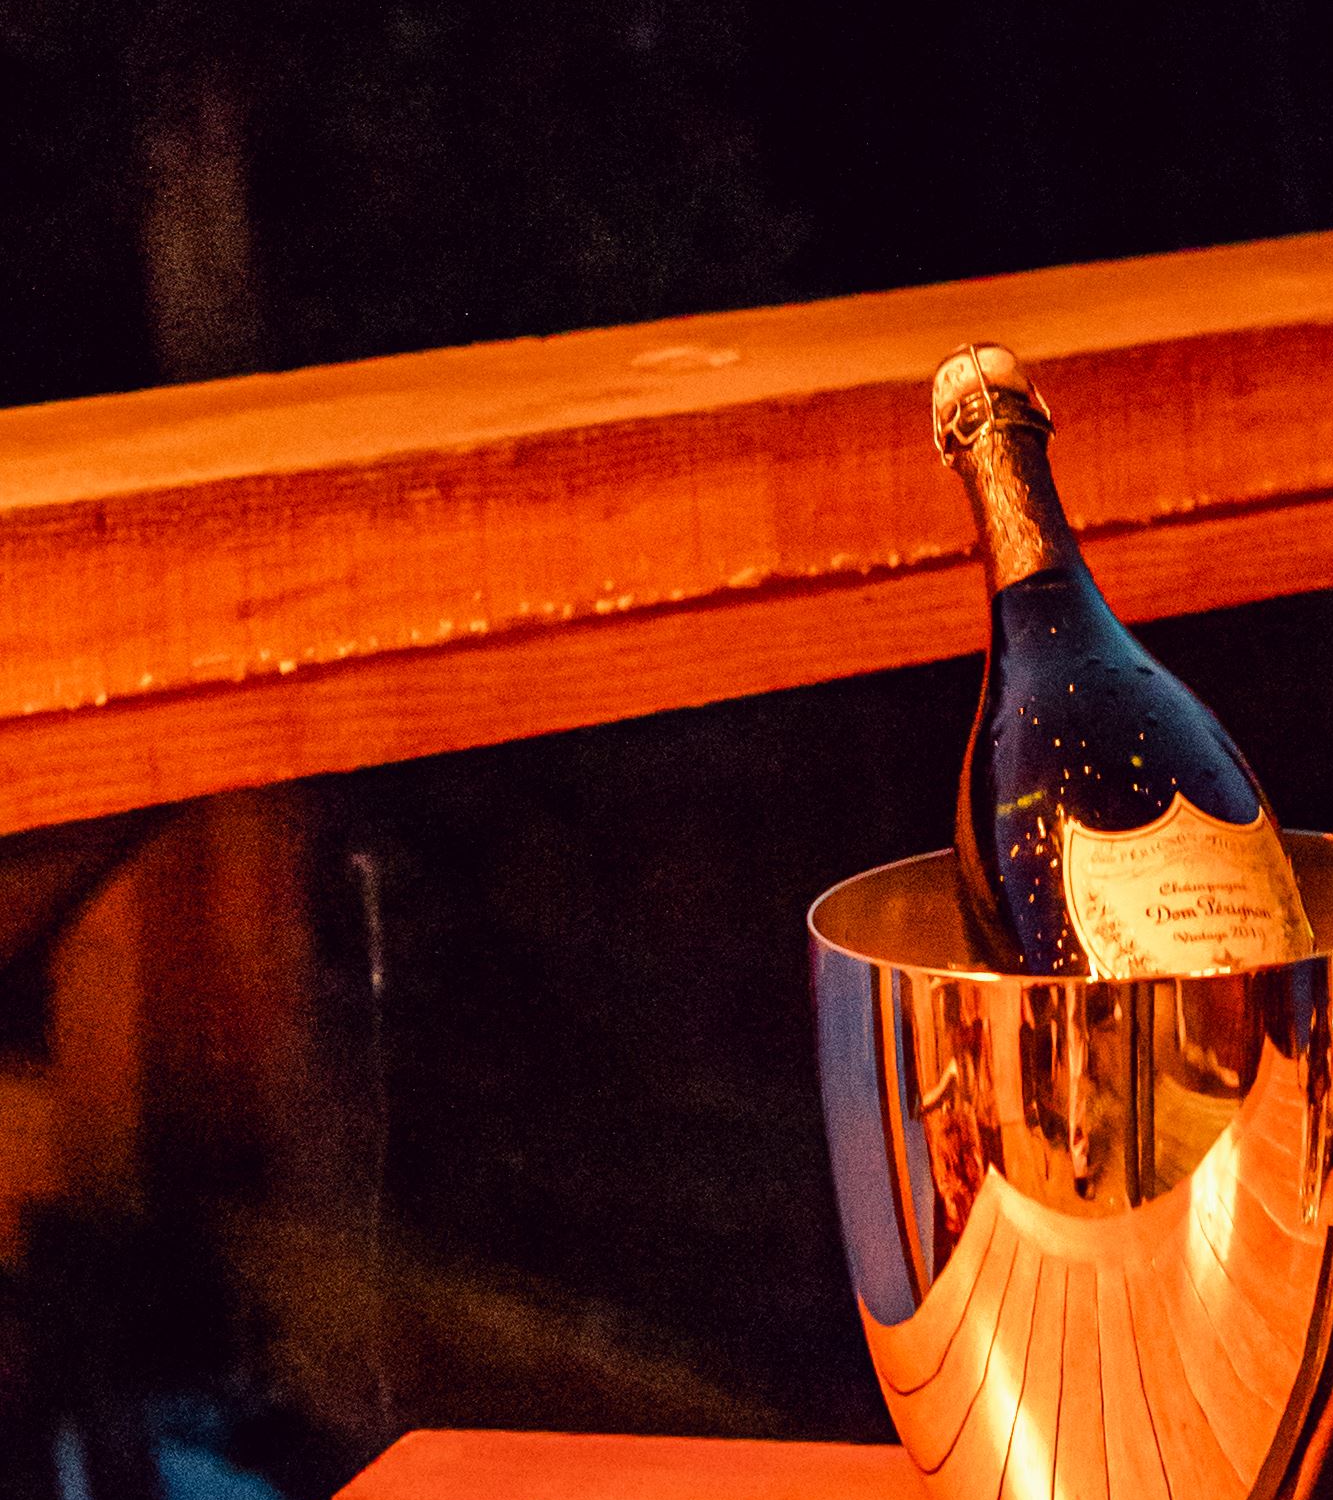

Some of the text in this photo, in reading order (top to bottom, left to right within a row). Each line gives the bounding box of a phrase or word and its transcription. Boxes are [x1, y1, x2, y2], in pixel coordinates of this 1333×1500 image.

[1159, 881, 1248, 896] Champagne
[1145, 895, 1272, 925] Dom Pérignon
